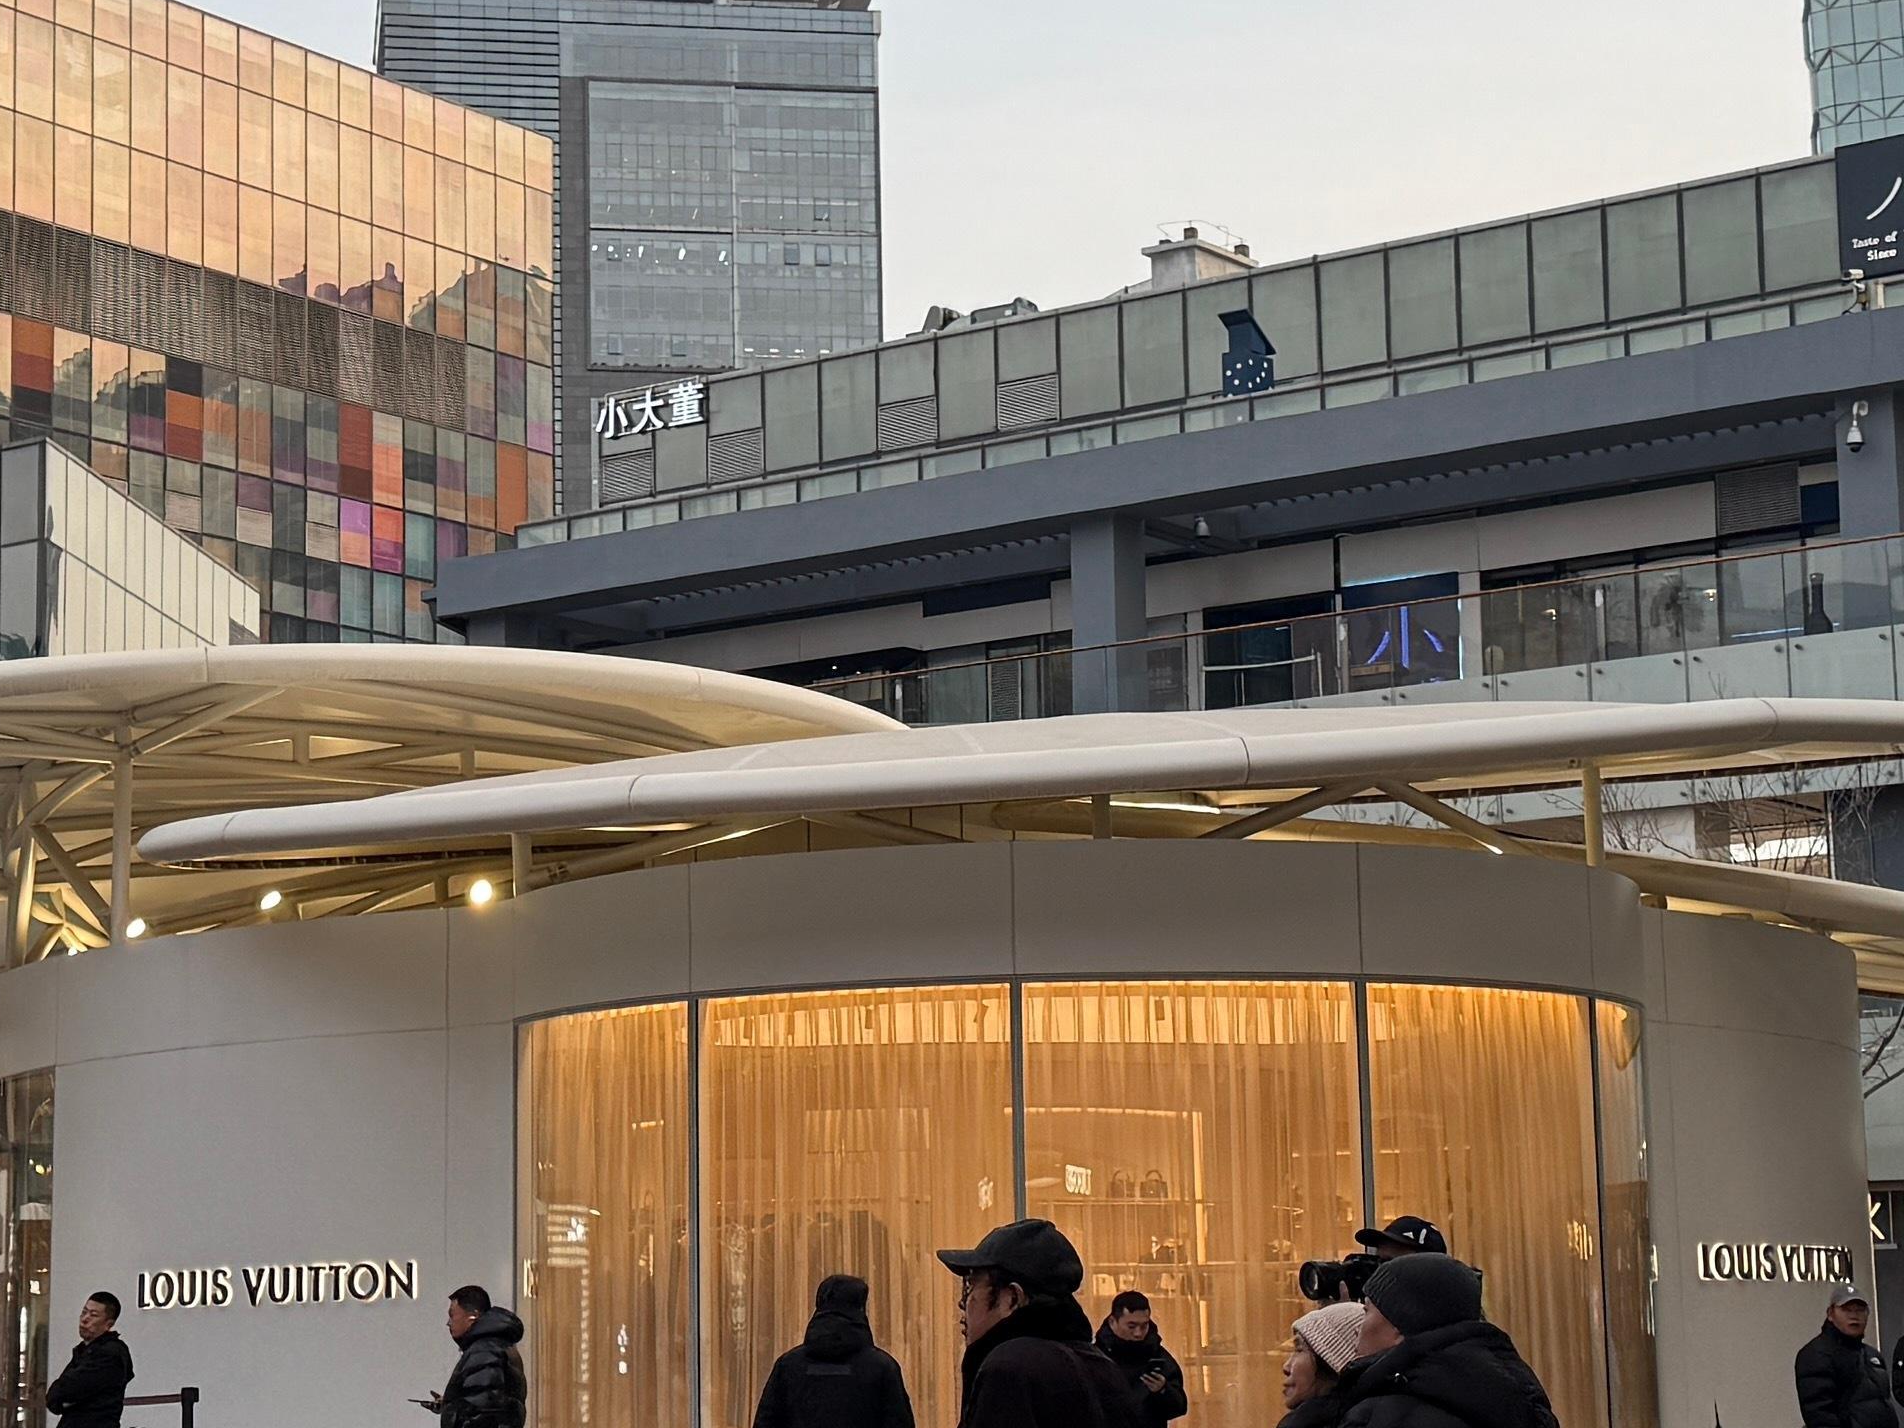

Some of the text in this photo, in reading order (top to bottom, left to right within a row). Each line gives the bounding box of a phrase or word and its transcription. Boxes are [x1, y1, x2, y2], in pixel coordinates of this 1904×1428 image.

[1866, 246, 1897, 261] Since
[1885, 231, 1898, 242] of
[595, 381, 704, 439] 小大董
[1697, 1242, 1777, 1282] LOUIS
[137, 1258, 419, 1311] LOUIS VUITTON
